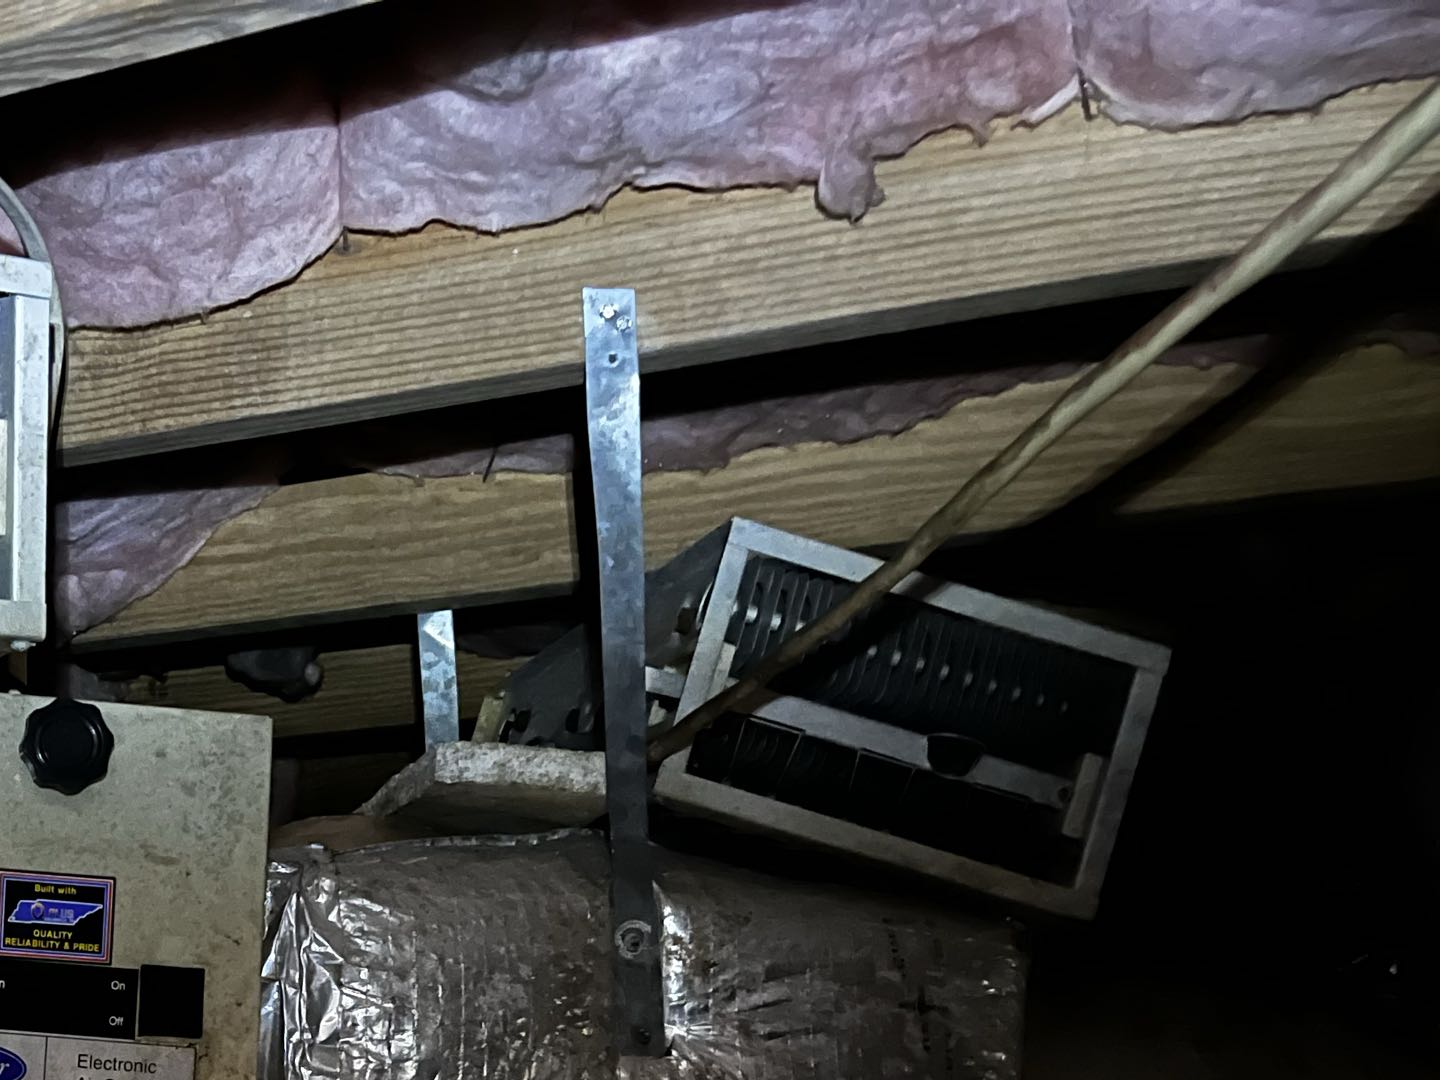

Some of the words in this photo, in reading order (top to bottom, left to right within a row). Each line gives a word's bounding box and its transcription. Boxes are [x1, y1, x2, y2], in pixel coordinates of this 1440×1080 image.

[34, 884, 55, 895] Built
[58, 887, 77, 895] with
[33, 929, 72, 939] QUALITY
[5, 937, 60, 948] RELIABILITY
[63, 942, 70, 950] &
[73, 942, 100, 952] PRIDE
[110, 980, 126, 991] On
[108, 1015, 124, 1026] Off
[77, 1054, 158, 1074] Electronic
